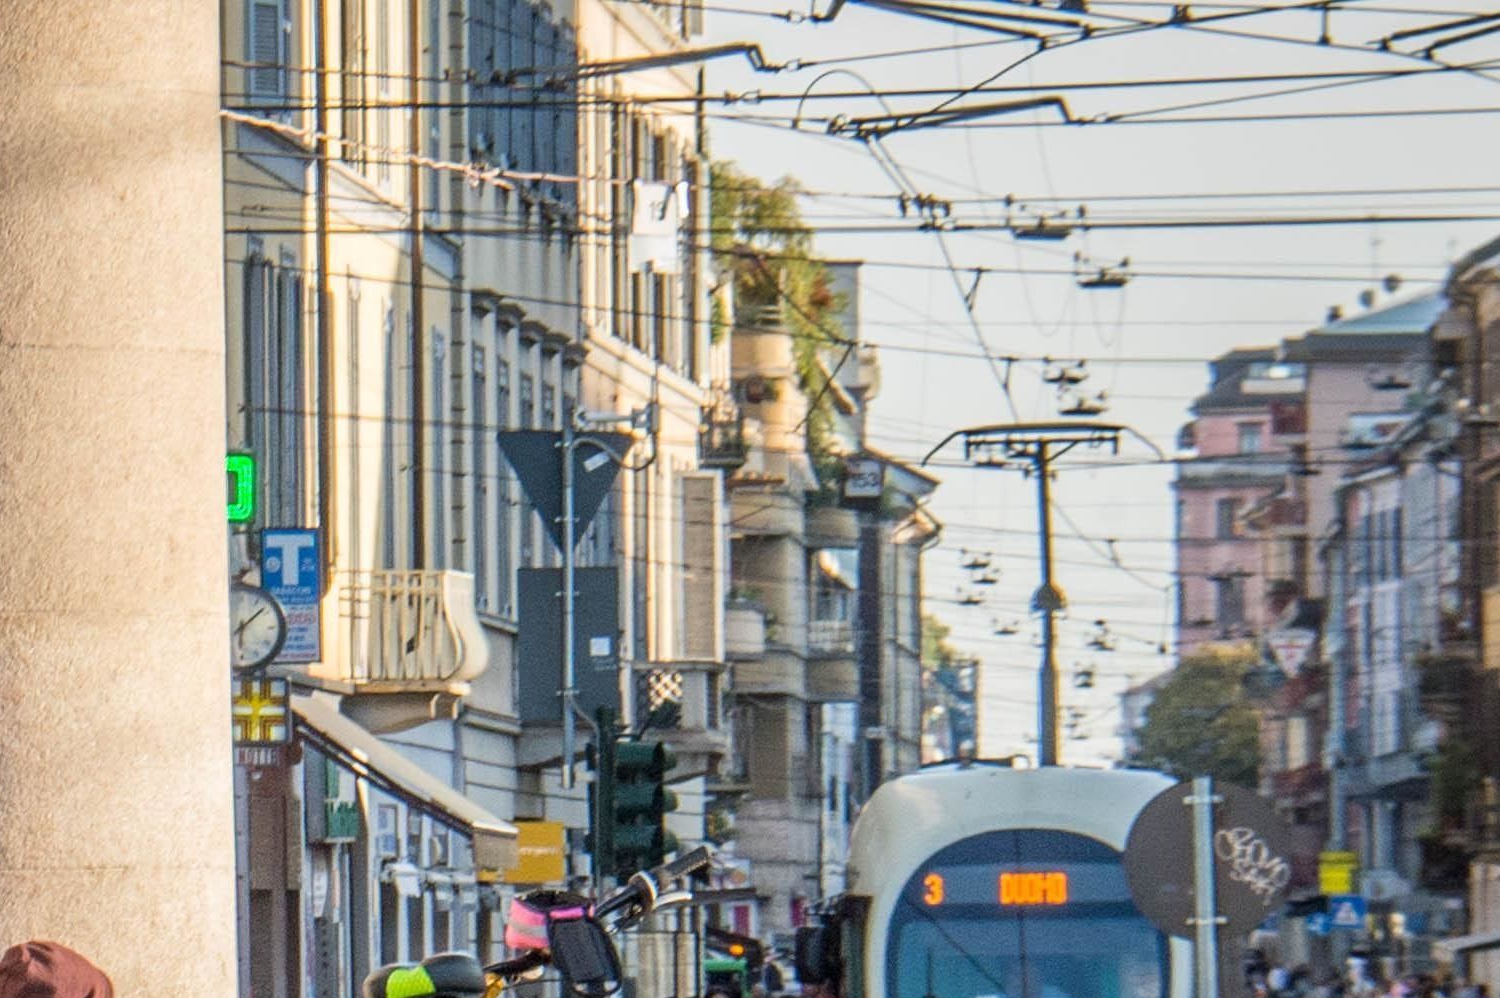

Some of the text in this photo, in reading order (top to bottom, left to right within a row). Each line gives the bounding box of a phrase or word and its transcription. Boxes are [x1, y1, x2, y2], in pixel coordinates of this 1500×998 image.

[266, 534, 315, 586] T
[923, 871, 1068, 906] 3 DUOMO
